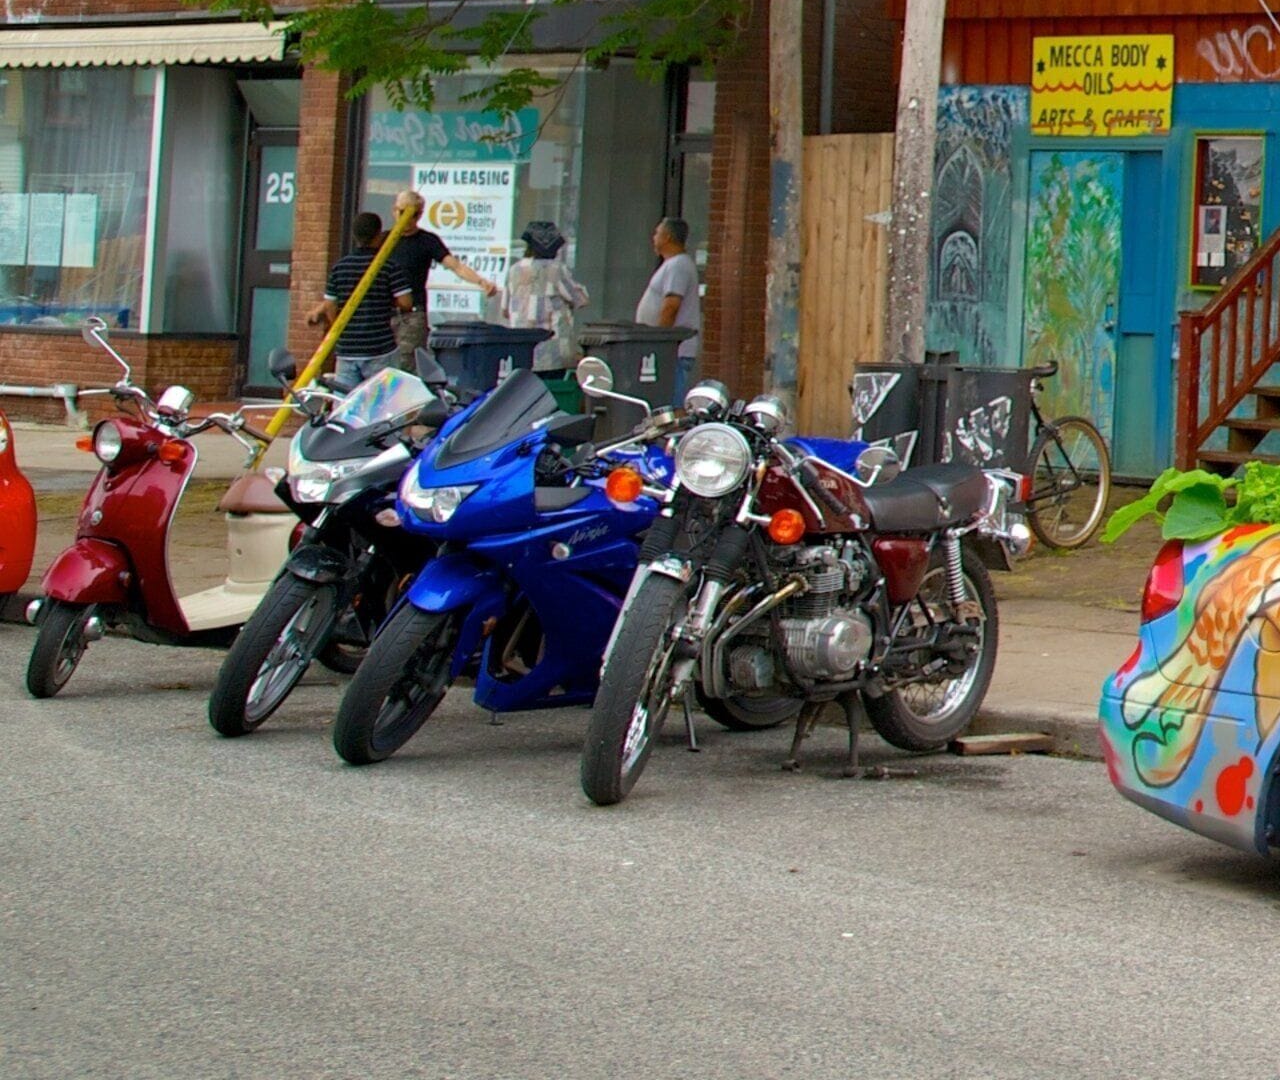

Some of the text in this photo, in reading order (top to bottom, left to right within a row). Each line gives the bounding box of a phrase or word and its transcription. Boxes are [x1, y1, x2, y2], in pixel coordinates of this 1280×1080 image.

[1050, 45, 1150, 67] MECCA BODY
[1083, 72, 1114, 95] OILS
[1037, 108, 1075, 128] ARTS
[418, 170, 510, 186] NOW LEASING
[467, 216, 497, 232] Realty
[453, 292, 470, 308] Pick
